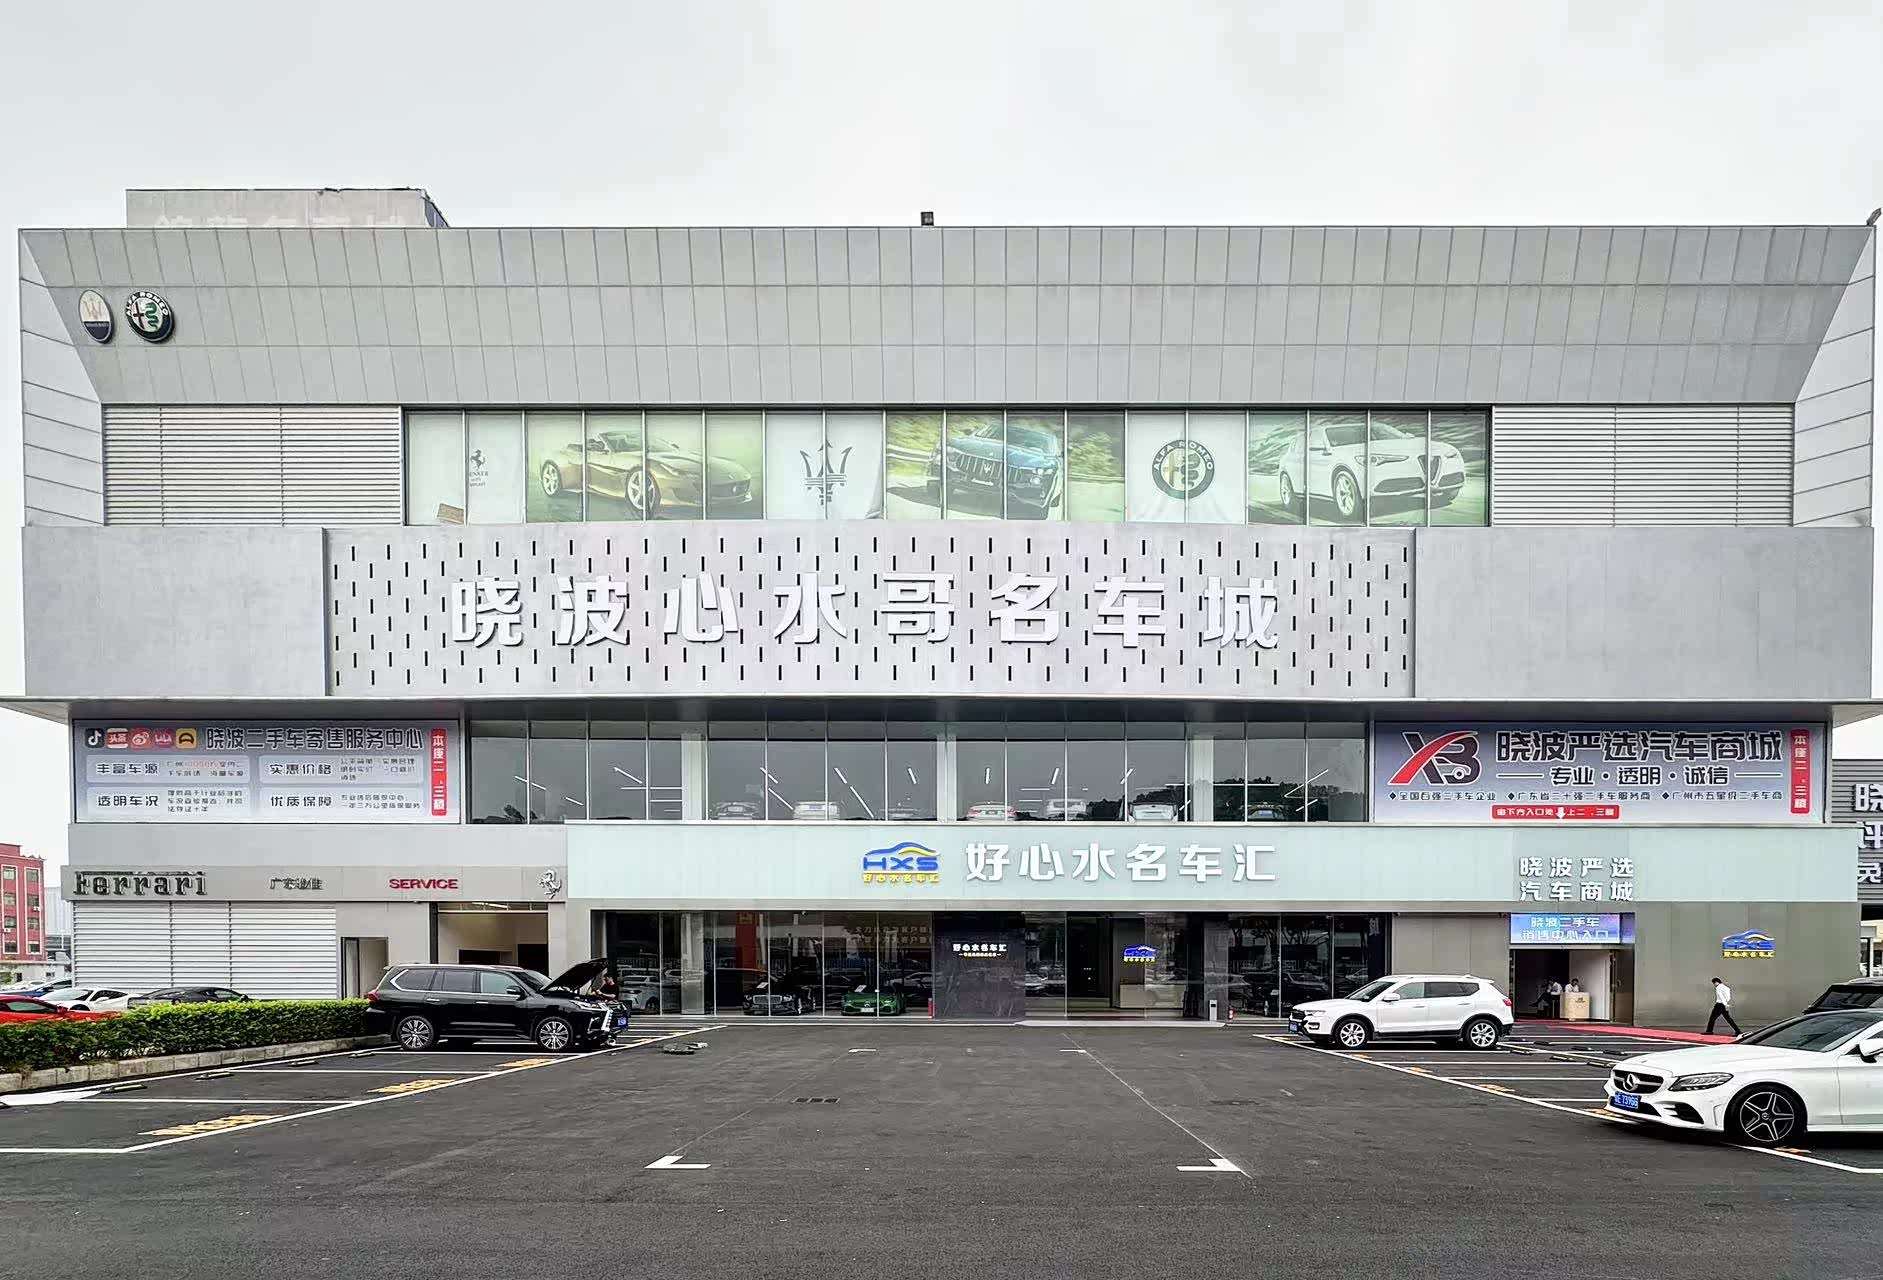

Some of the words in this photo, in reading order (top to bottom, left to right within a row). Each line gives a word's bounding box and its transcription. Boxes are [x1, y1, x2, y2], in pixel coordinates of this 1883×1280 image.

[140, 291, 169, 316] ROMEO
[1153, 444, 1174, 471] ALFA
[1179, 441, 1214, 470] ROMEO
[450, 571, 1279, 649] 晓波心水哥名车城
[206, 728, 424, 749] 晓波二手车寄售服务中心
[1495, 730, 1783, 762] 晓波严选汽车商城
[97, 763, 159, 774] 丰富车源
[270, 764, 332, 775] 实惠价格
[97, 796, 159, 807] 透明车况
[271, 796, 332, 807] 优质保障
[863, 856, 939, 871] HXS
[966, 843, 1277, 881] 好心水名车汇
[1519, 857, 1634, 878] 晓波严选
[73, 871, 207, 896] Ferrari
[389, 879, 459, 889] SERVICE
[1519, 881, 1634, 901] 汽车商城
[1530, 917, 1600, 928] 晓波二手车
